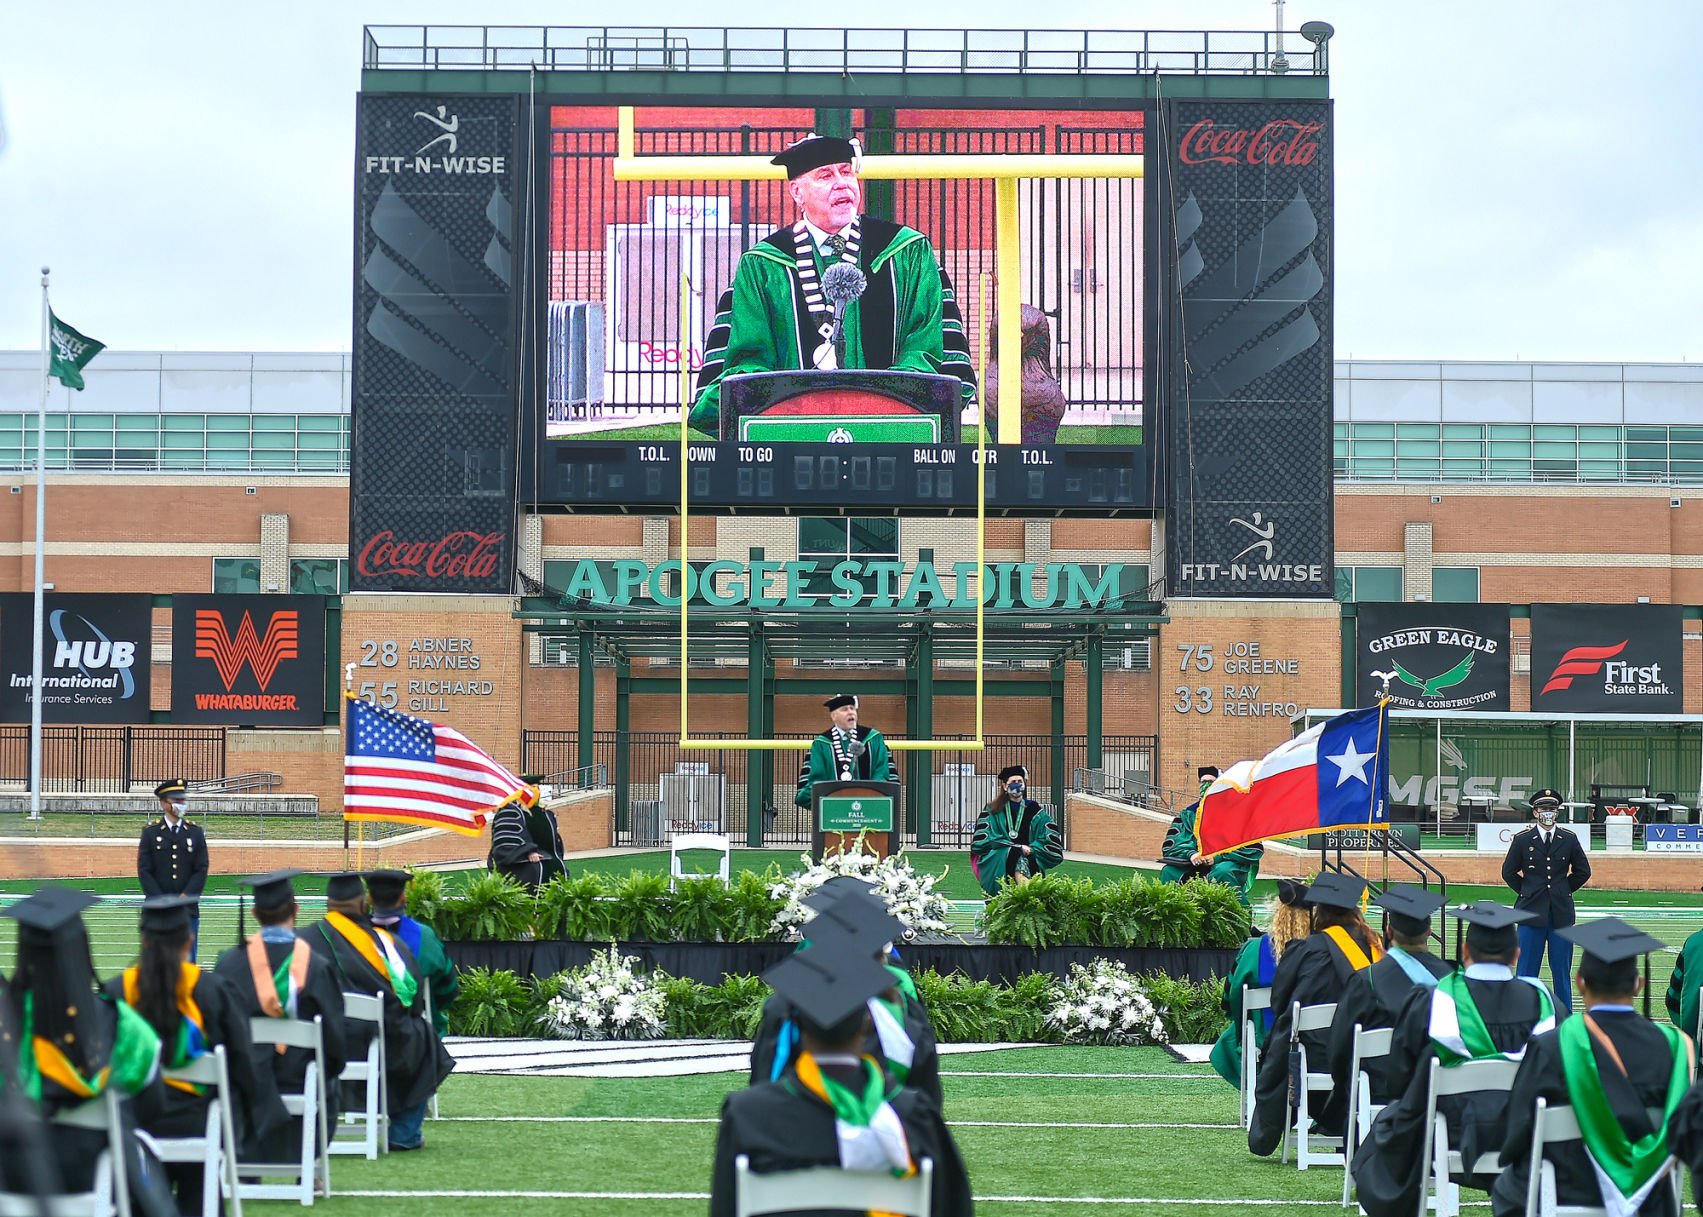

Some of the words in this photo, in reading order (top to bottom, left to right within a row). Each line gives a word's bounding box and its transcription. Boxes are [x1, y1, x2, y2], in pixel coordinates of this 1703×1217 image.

[1180, 119, 1327, 165] Coca-Cola
[366, 156, 505, 173] FIT-N-WISE
[666, 204, 719, 219] Reddyce
[638, 446, 670, 461] T.O.L.
[686, 446, 716, 461] OWN
[738, 447, 753, 462] TO
[757, 447, 773, 462] GO
[914, 449, 938, 464] BALL
[942, 450, 956, 464] ON
[972, 449, 997, 464] QTR
[1021, 450, 1053, 465] T.O.L.
[358, 530, 507, 577] Coca-Cola
[1181, 564, 1322, 581] FIT-N-WISE
[566, 559, 818, 607] APOGEE
[829, 560, 1126, 609] STADIUM
[408, 638, 472, 652] ABNER
[1224, 642, 1260, 657] JOE
[1369, 630, 1431, 653] GREEN
[1436, 630, 1498, 654] EAGLE
[53, 641, 136, 668] HUB
[360, 640, 399, 667] 28
[1177, 644, 1213, 672] 75
[408, 655, 480, 669] HAYNES
[1224, 659, 1299, 674] GREENE
[1605, 661, 1661, 684] First
[10, 673, 118, 688] Intrnational
[408, 680, 494, 695] RICHARD
[360, 681, 398, 709] 55
[1223, 685, 1260, 699] RAY
[1605, 684, 1636, 695] State
[25, 693, 71, 704] Inurance
[73, 693, 113, 704] Services
[195, 694, 298, 711] WHATABURGER
[408, 697, 449, 711] GILL
[1174, 686, 1213, 714] 33
[1374, 689, 1415, 708] ROOFING
[1417, 699, 1425, 708] &
[1426, 689, 1497, 709] CONSTRUCTION
[1223, 702, 1298, 717] RENFRO
[1388, 775, 1533, 806] MGSF
[1328, 837, 1400, 847] PROPERTES
